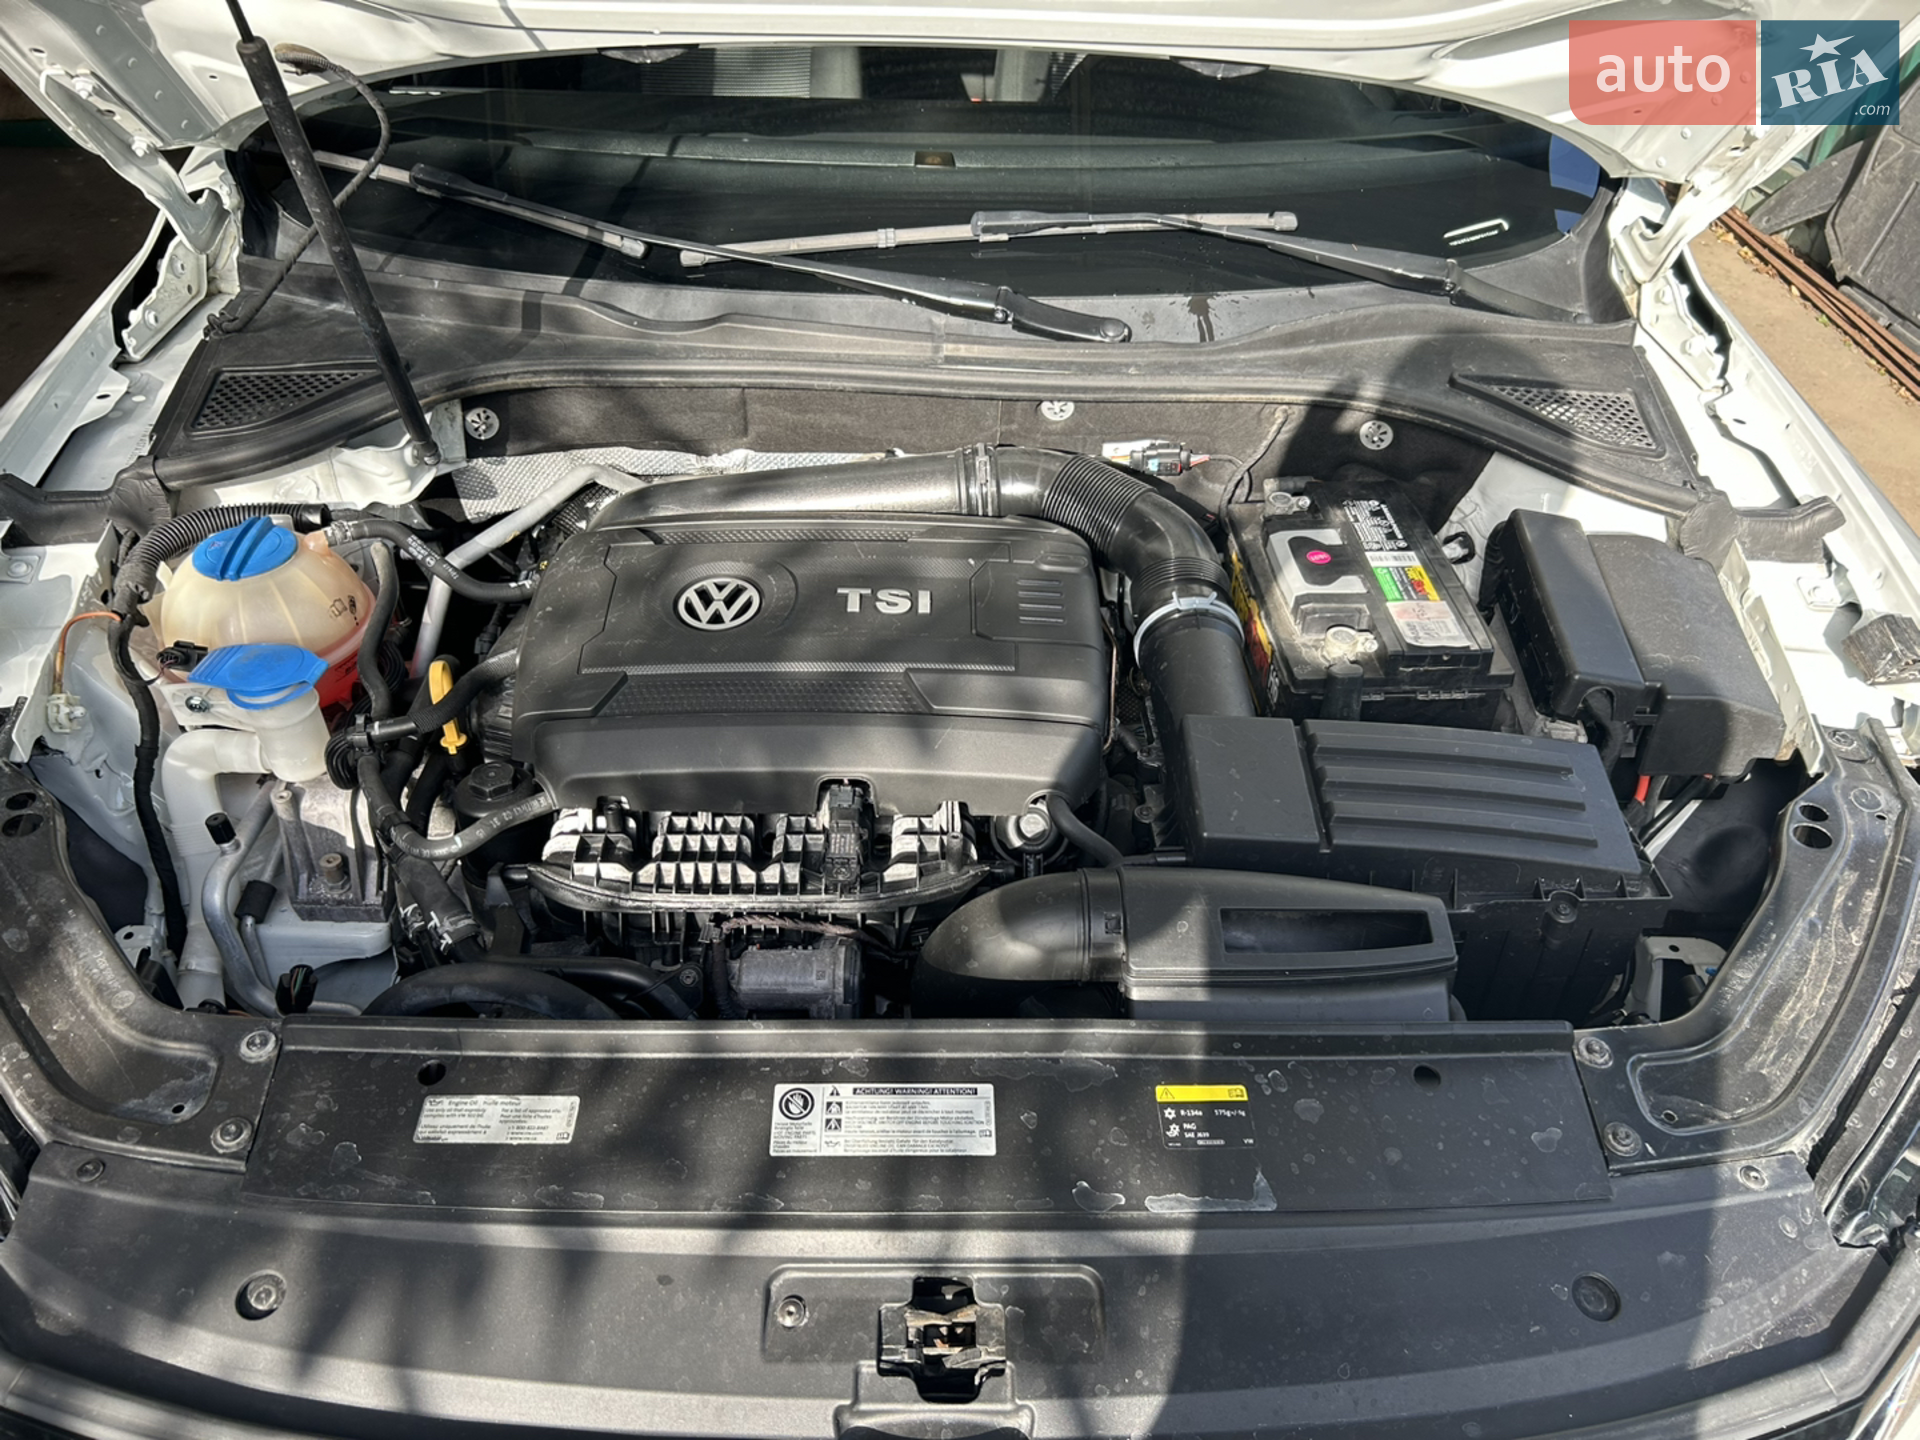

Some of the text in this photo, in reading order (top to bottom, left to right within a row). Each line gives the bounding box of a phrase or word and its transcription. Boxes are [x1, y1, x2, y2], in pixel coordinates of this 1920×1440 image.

[836, 587, 932, 614] TSI
[855, 1087, 976, 1095] ACHTUNG! WARNING! ATTENTION!
